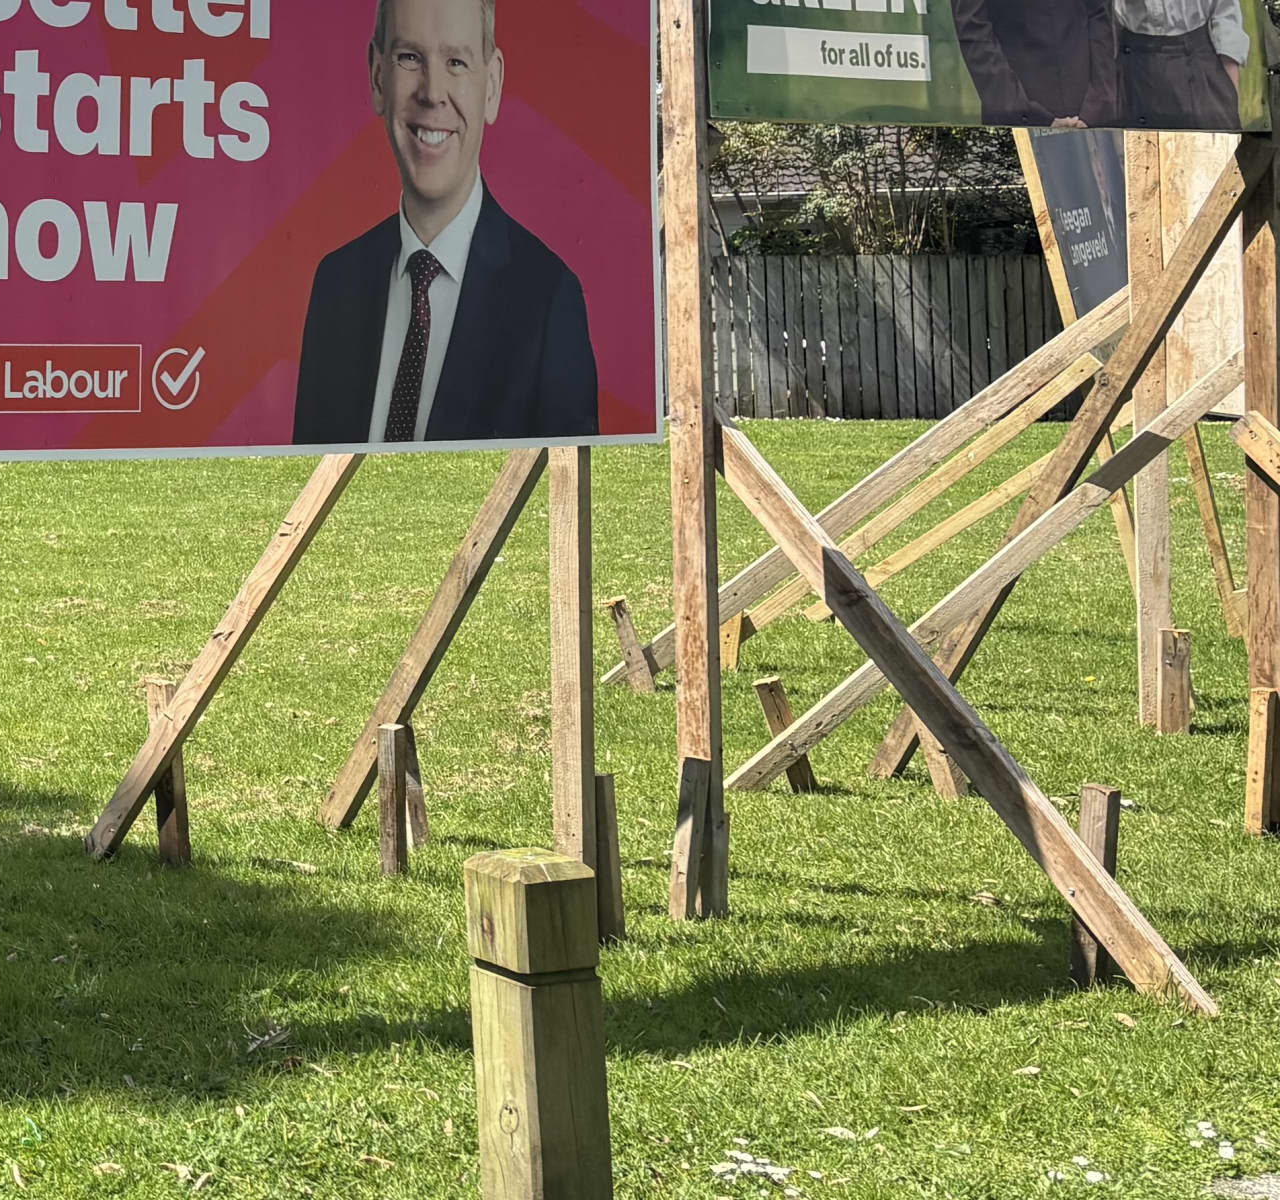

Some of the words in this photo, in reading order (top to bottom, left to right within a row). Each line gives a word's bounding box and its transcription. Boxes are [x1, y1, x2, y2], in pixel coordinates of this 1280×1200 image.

[820, 40, 845, 65] for
[849, 42, 869, 67] all
[874, 43, 893, 68] of
[896, 49, 926, 69] us.
[1069, 231, 1109, 267] angeveld
[4, 360, 128, 398] Labour
